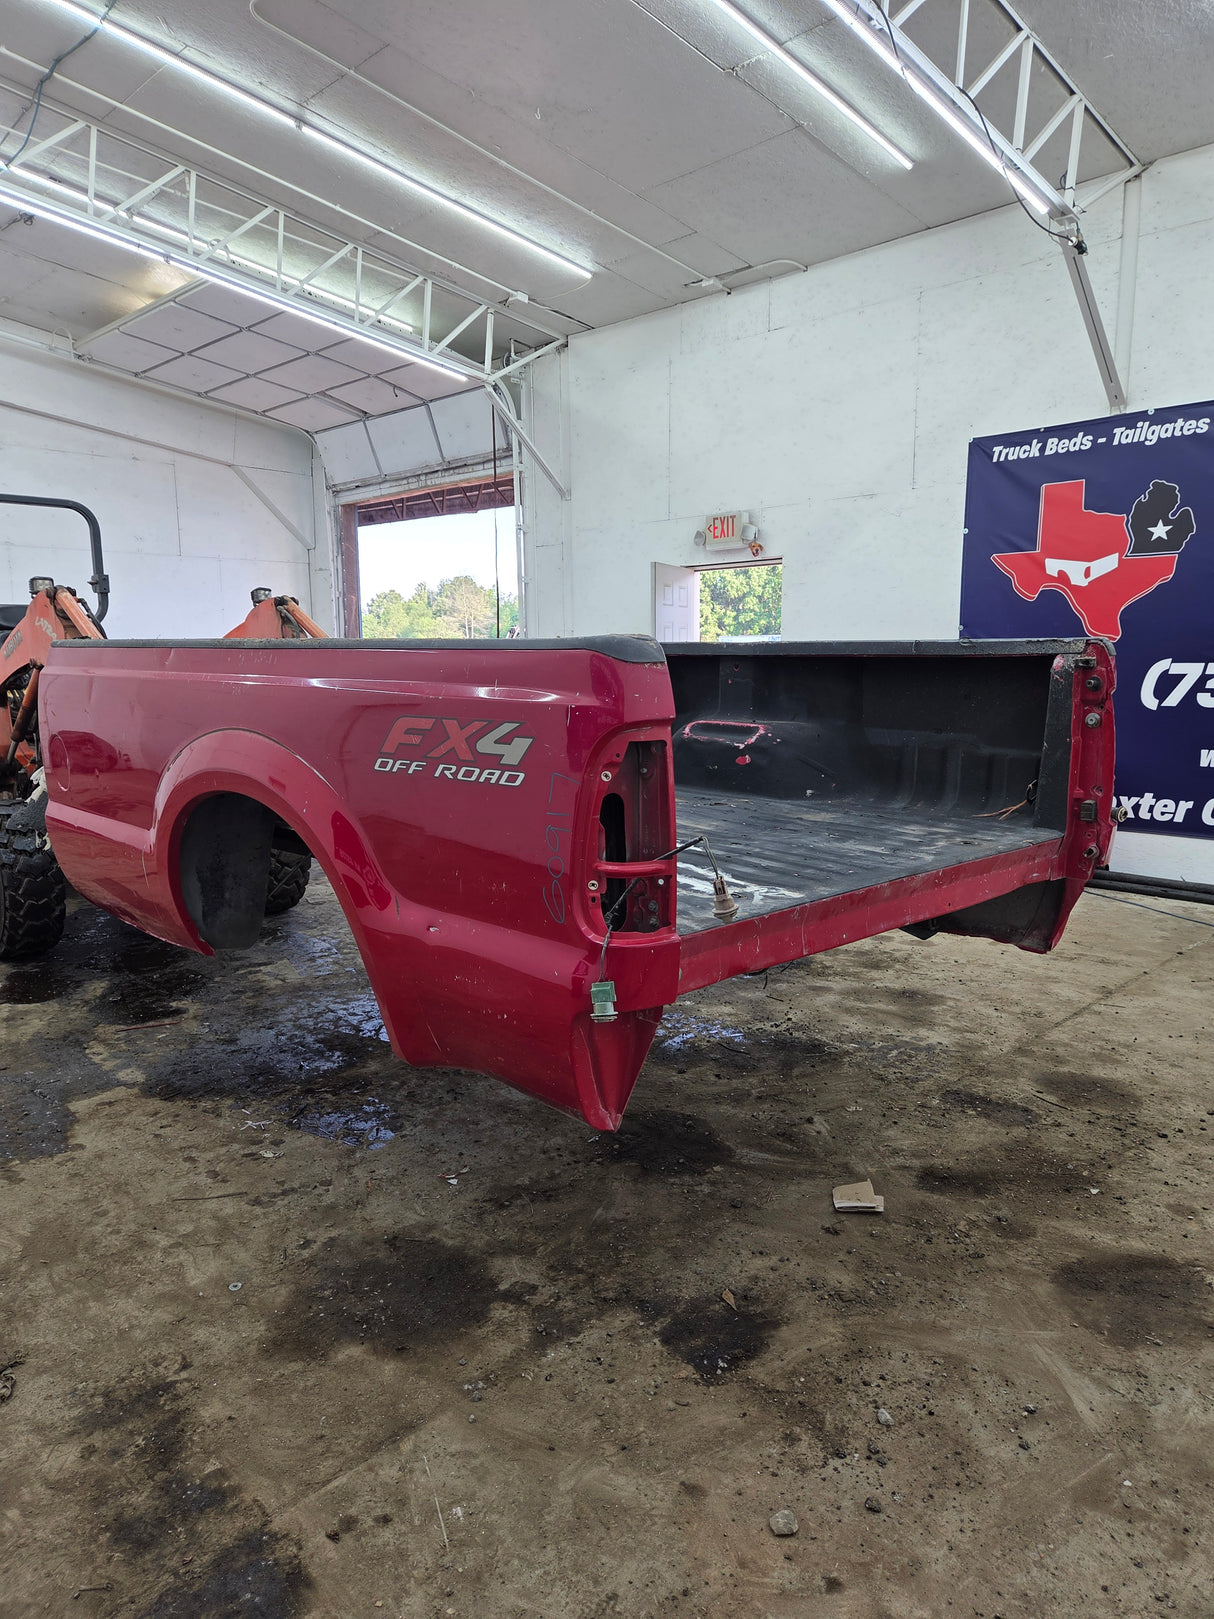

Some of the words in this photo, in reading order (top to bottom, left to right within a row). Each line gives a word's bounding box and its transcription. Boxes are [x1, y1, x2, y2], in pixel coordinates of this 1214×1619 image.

[992, 439, 1043, 463] Truck
[1044, 432, 1093, 456] Beds
[1112, 417, 1210, 446] Tailgates
[712, 514, 737, 539] EXIT
[378, 715, 535, 766] FX4
[374, 758, 427, 774] OFF
[433, 764, 526, 787] ROAD
[1113, 792, 1194, 823] xter
[543, 772, 581, 924] 60917
